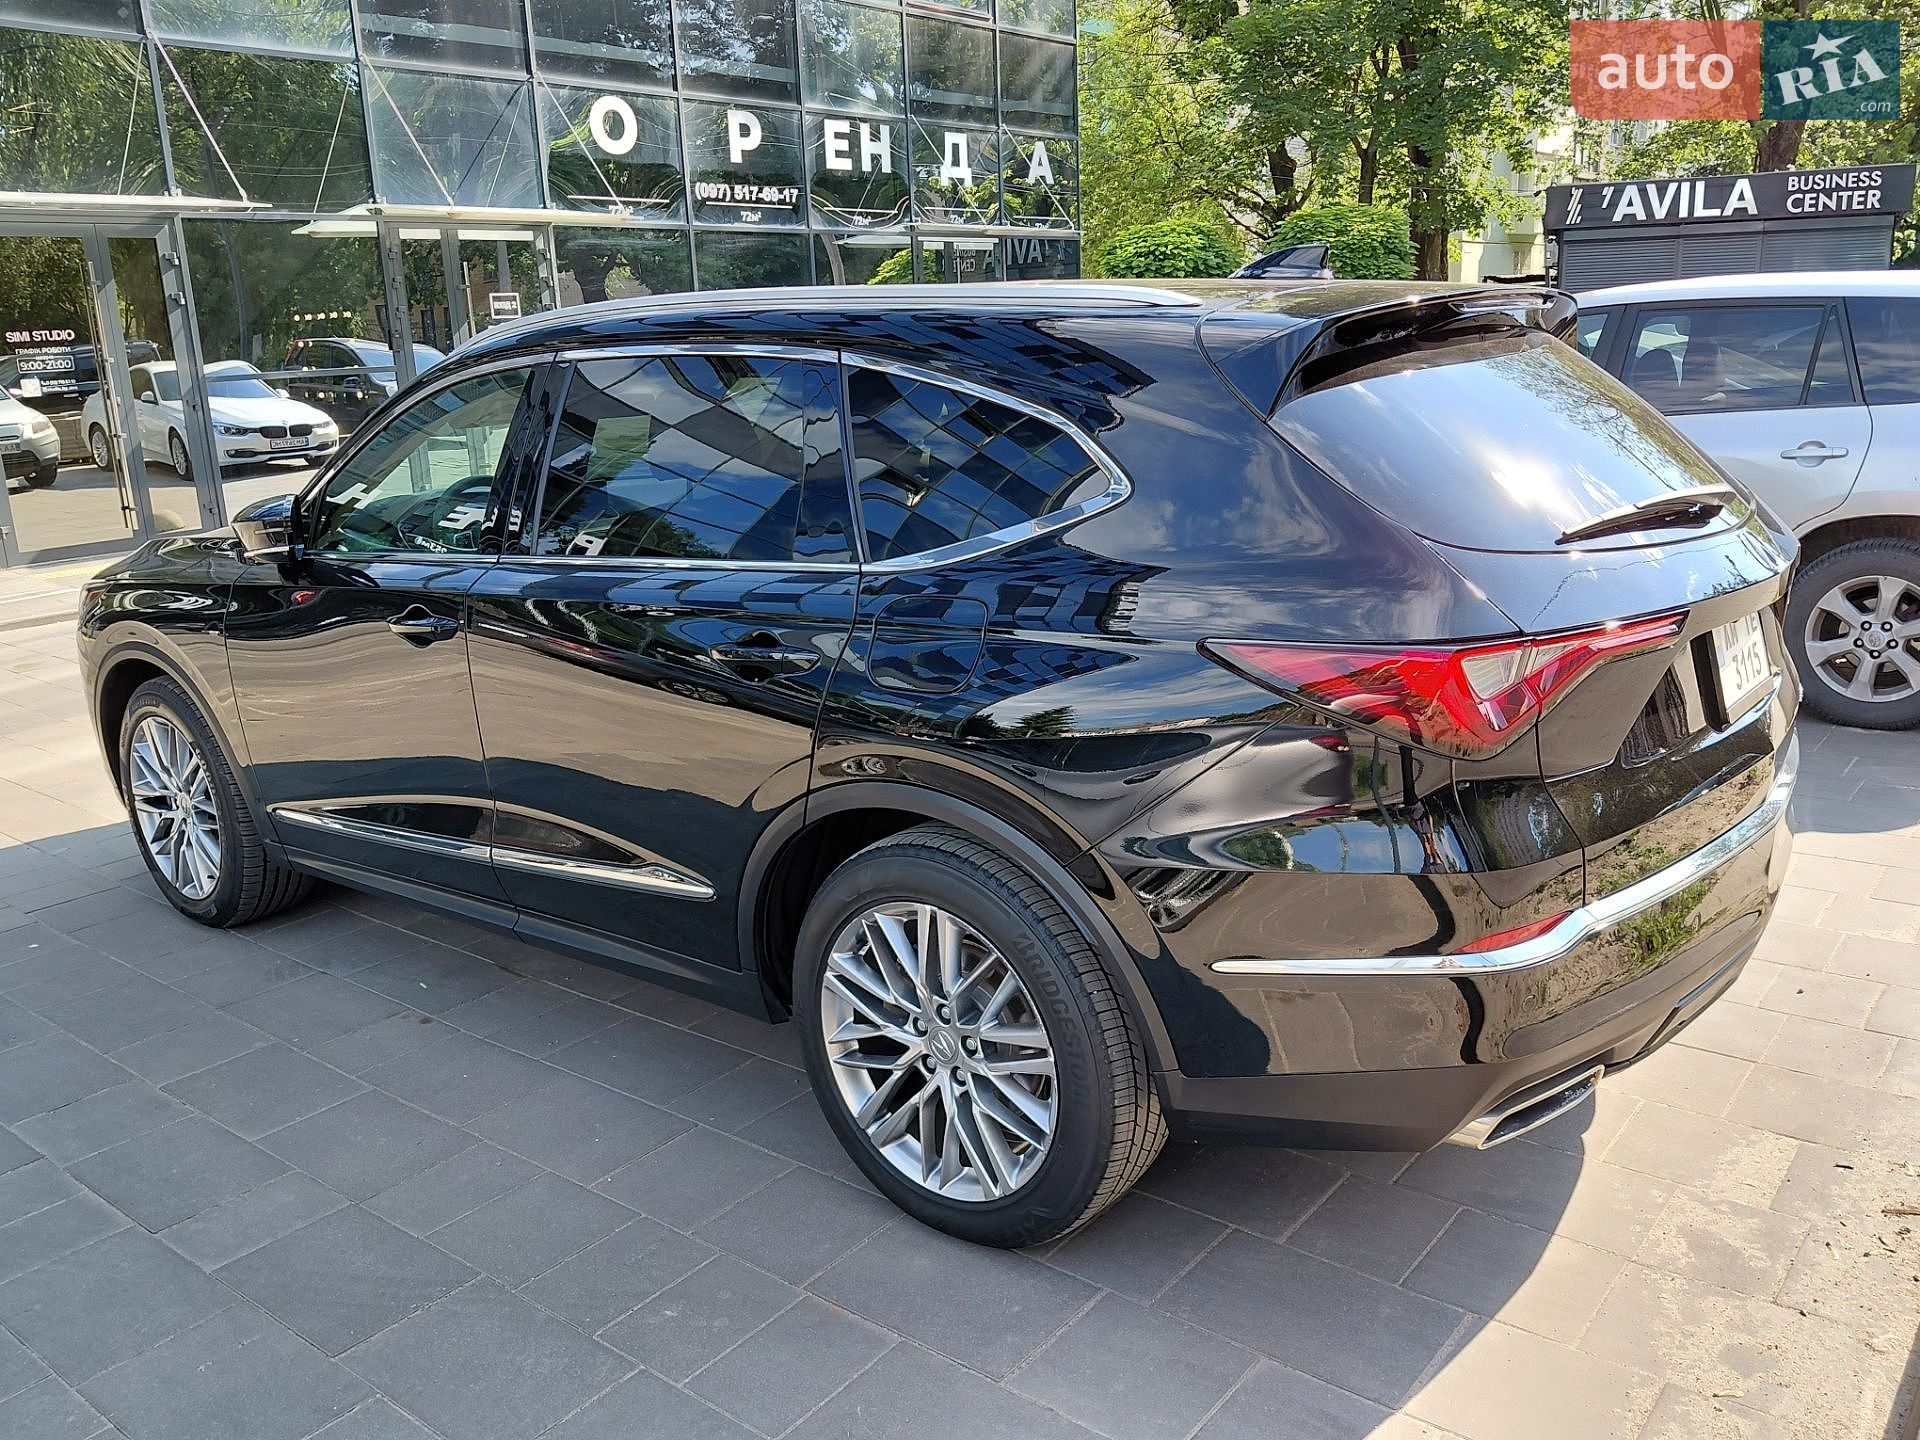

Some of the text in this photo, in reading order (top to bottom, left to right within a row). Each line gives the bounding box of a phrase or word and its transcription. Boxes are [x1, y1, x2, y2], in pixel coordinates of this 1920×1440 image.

[1786, 170, 1883, 192] BUSINESS
[1785, 189, 1882, 214] CENTER
[5, 329, 75, 342] SIMI STUDIO
[20, 360, 72, 371] 9:00-21:00
[1732, 641, 1762, 690] 3115
